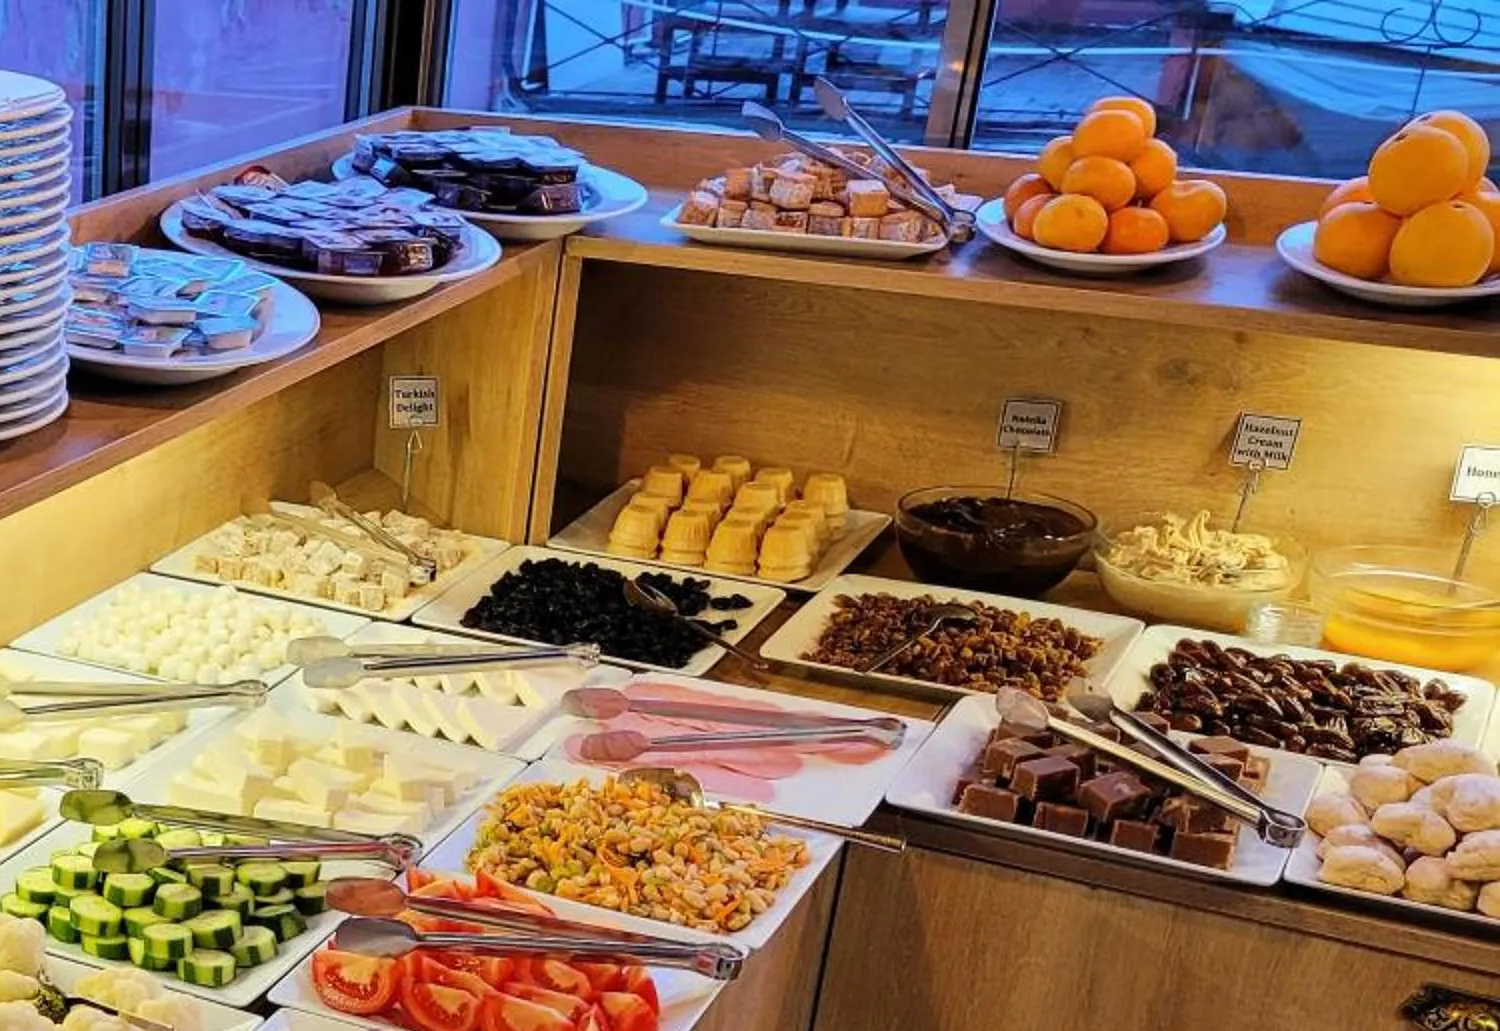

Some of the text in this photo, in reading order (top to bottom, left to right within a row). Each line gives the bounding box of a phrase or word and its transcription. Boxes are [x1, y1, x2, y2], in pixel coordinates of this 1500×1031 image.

[395, 388, 435, 398] Turkish
[396, 403, 433, 413] Delight
[1244, 423, 1293, 436] Hazelnut
[1248, 436, 1283, 449] Cream
[1237, 447, 1287, 462] with Milk
